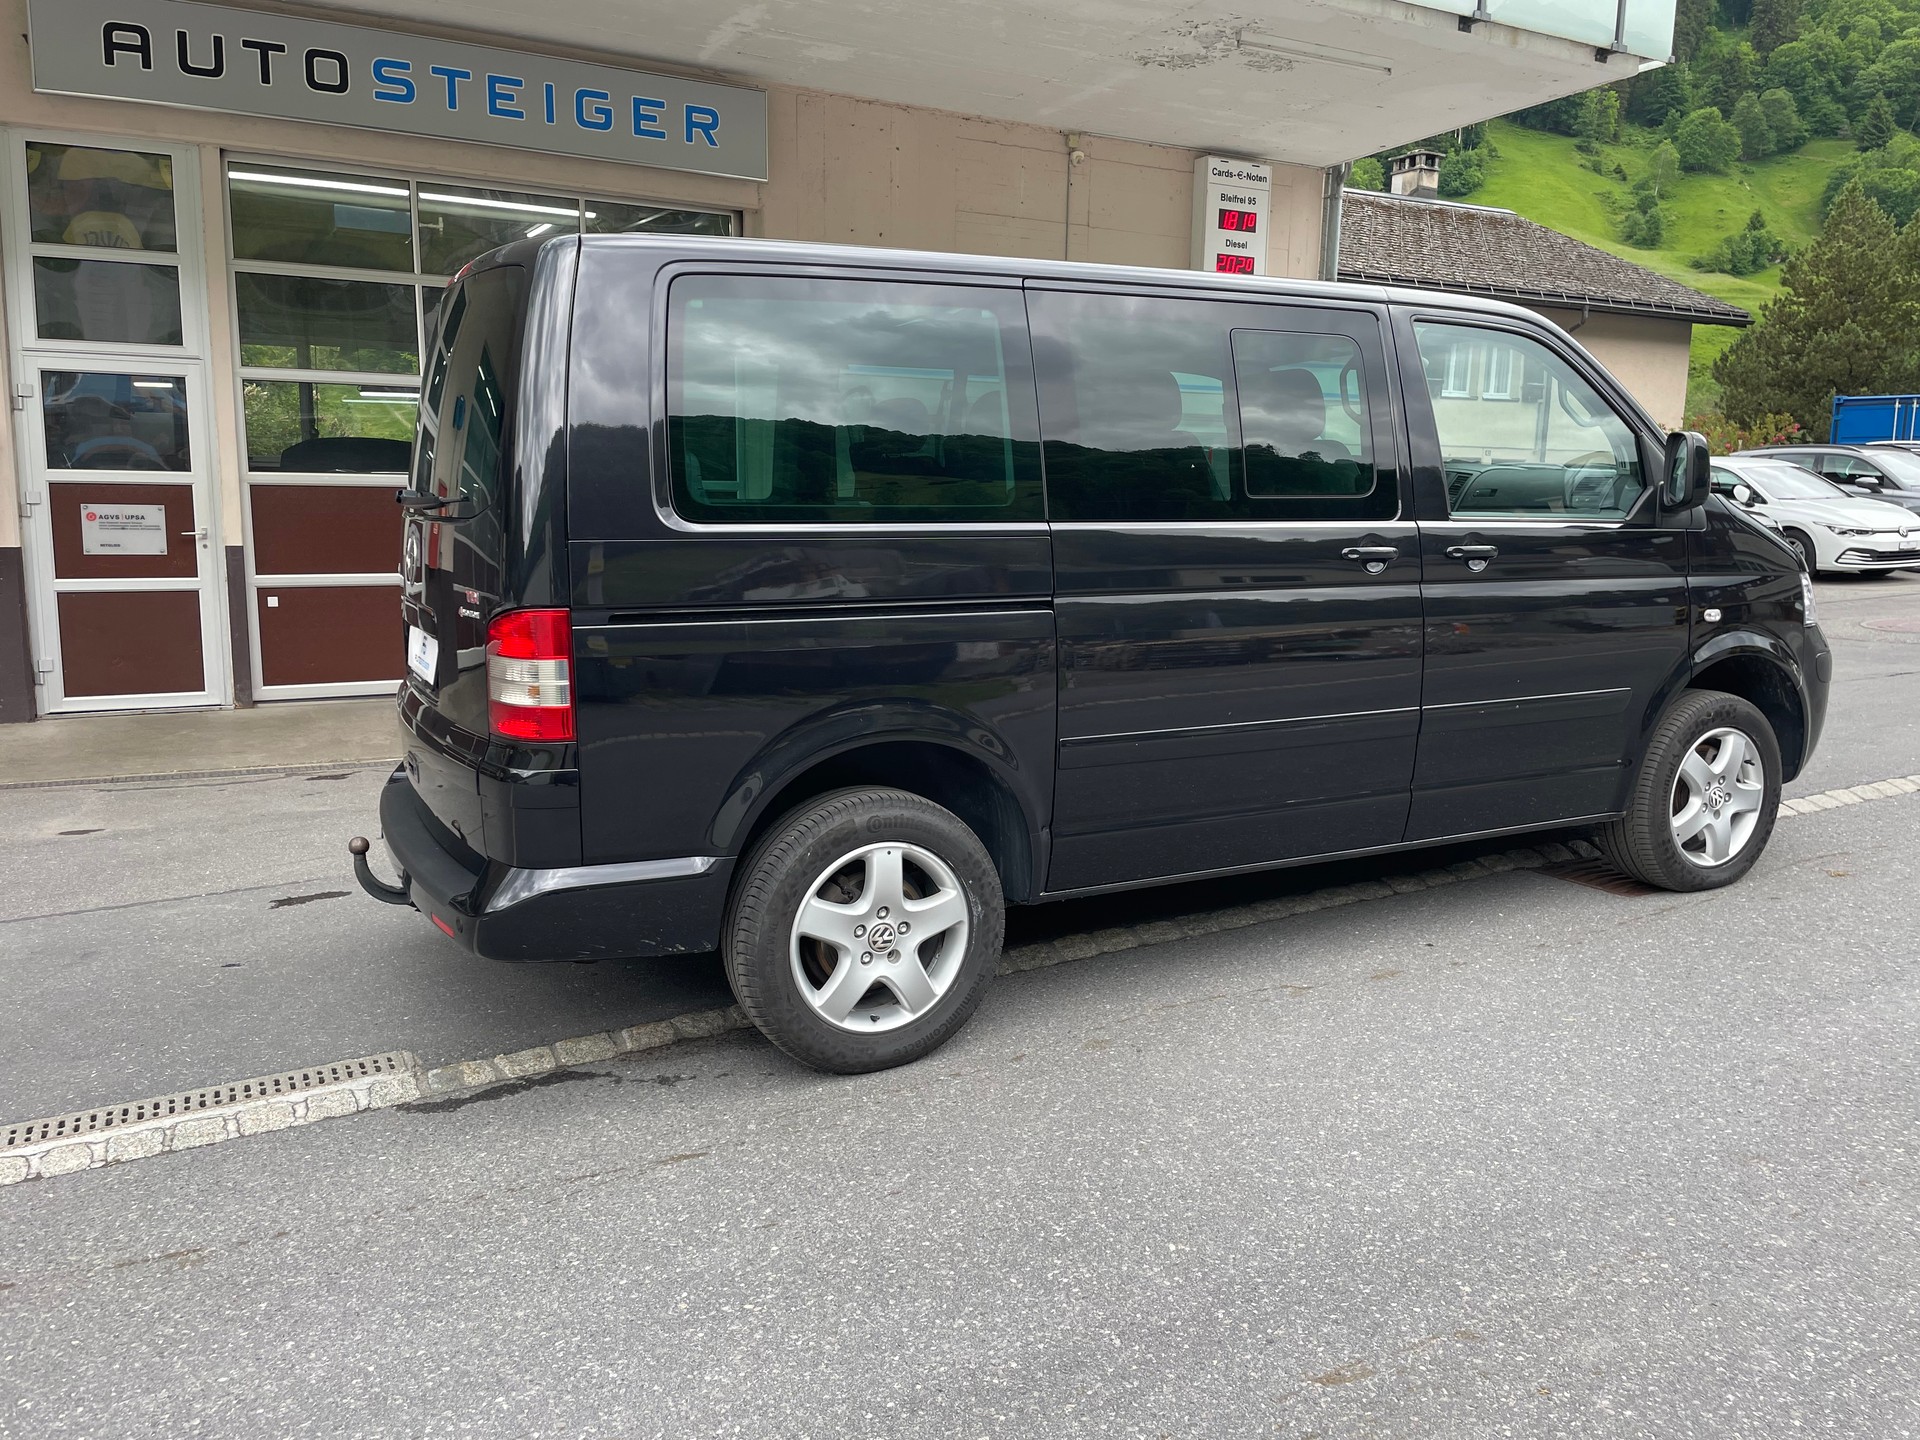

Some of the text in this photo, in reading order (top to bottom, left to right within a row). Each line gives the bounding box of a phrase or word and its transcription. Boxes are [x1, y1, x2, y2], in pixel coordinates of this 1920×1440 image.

[1220, 193, 1257, 206] Bleifrei 95
[1225, 239, 1248, 250] Diesel
